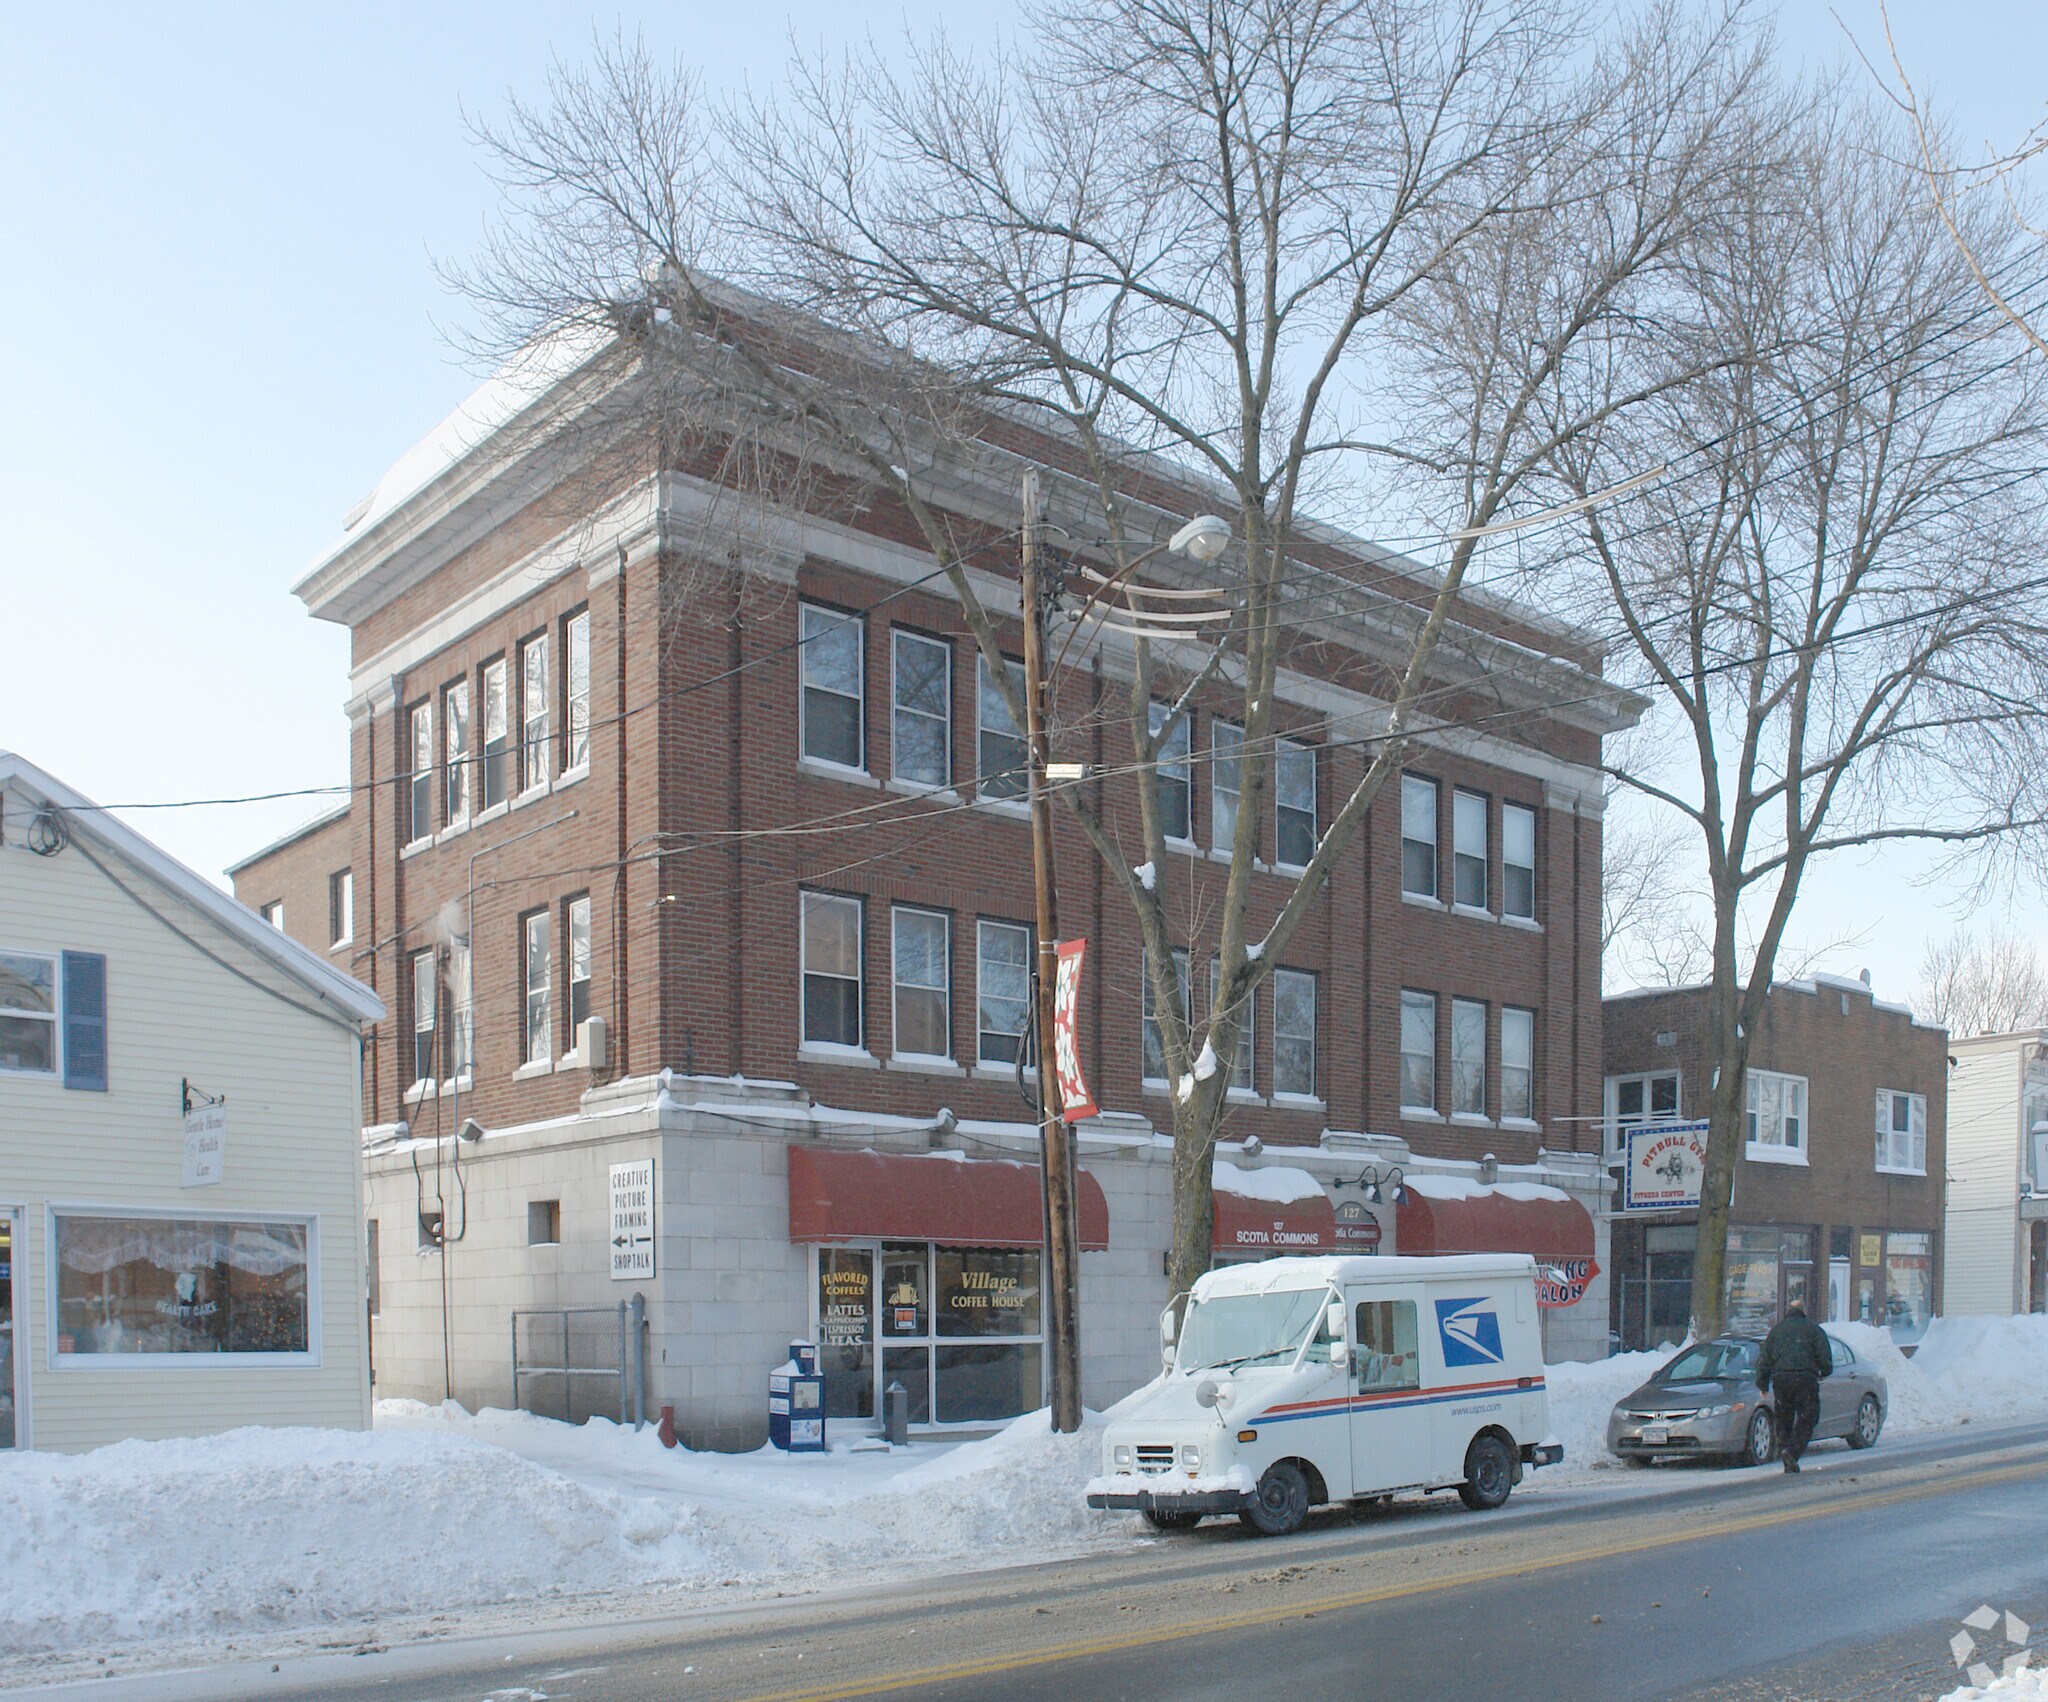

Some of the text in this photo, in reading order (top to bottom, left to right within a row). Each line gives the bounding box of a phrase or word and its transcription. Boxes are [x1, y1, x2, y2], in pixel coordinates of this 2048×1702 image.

[1642, 1136, 1686, 1168] PITBULL
[612, 1169, 649, 1189] CREATIVE
[615, 1190, 646, 1209] PICTURE
[1634, 1191, 1660, 1199] FITNESS
[1661, 1190, 1685, 1198] CENTER
[1344, 1207, 1360, 1218] 127
[614, 1211, 647, 1229] FRAMING
[1273, 1221, 1284, 1230] 127
[629, 1232, 634, 1248] &
[1236, 1231, 1319, 1245] SCOTIA COMMONS
[1347, 1228, 1378, 1239] Commons
[614, 1253, 650, 1270] SHOPTALK
[822, 1271, 868, 1286] FLAVORED
[961, 1271, 1018, 1294] Village
[826, 1286, 865, 1296] COFFEES
[951, 1295, 1025, 1308] COFFEE HOUSE
[827, 1304, 865, 1316] LATTES
[828, 1325, 865, 1334] ESPRESSOS
[830, 1335, 863, 1346] TEAS
[1450, 1403, 1502, 1416] www.usps.com
